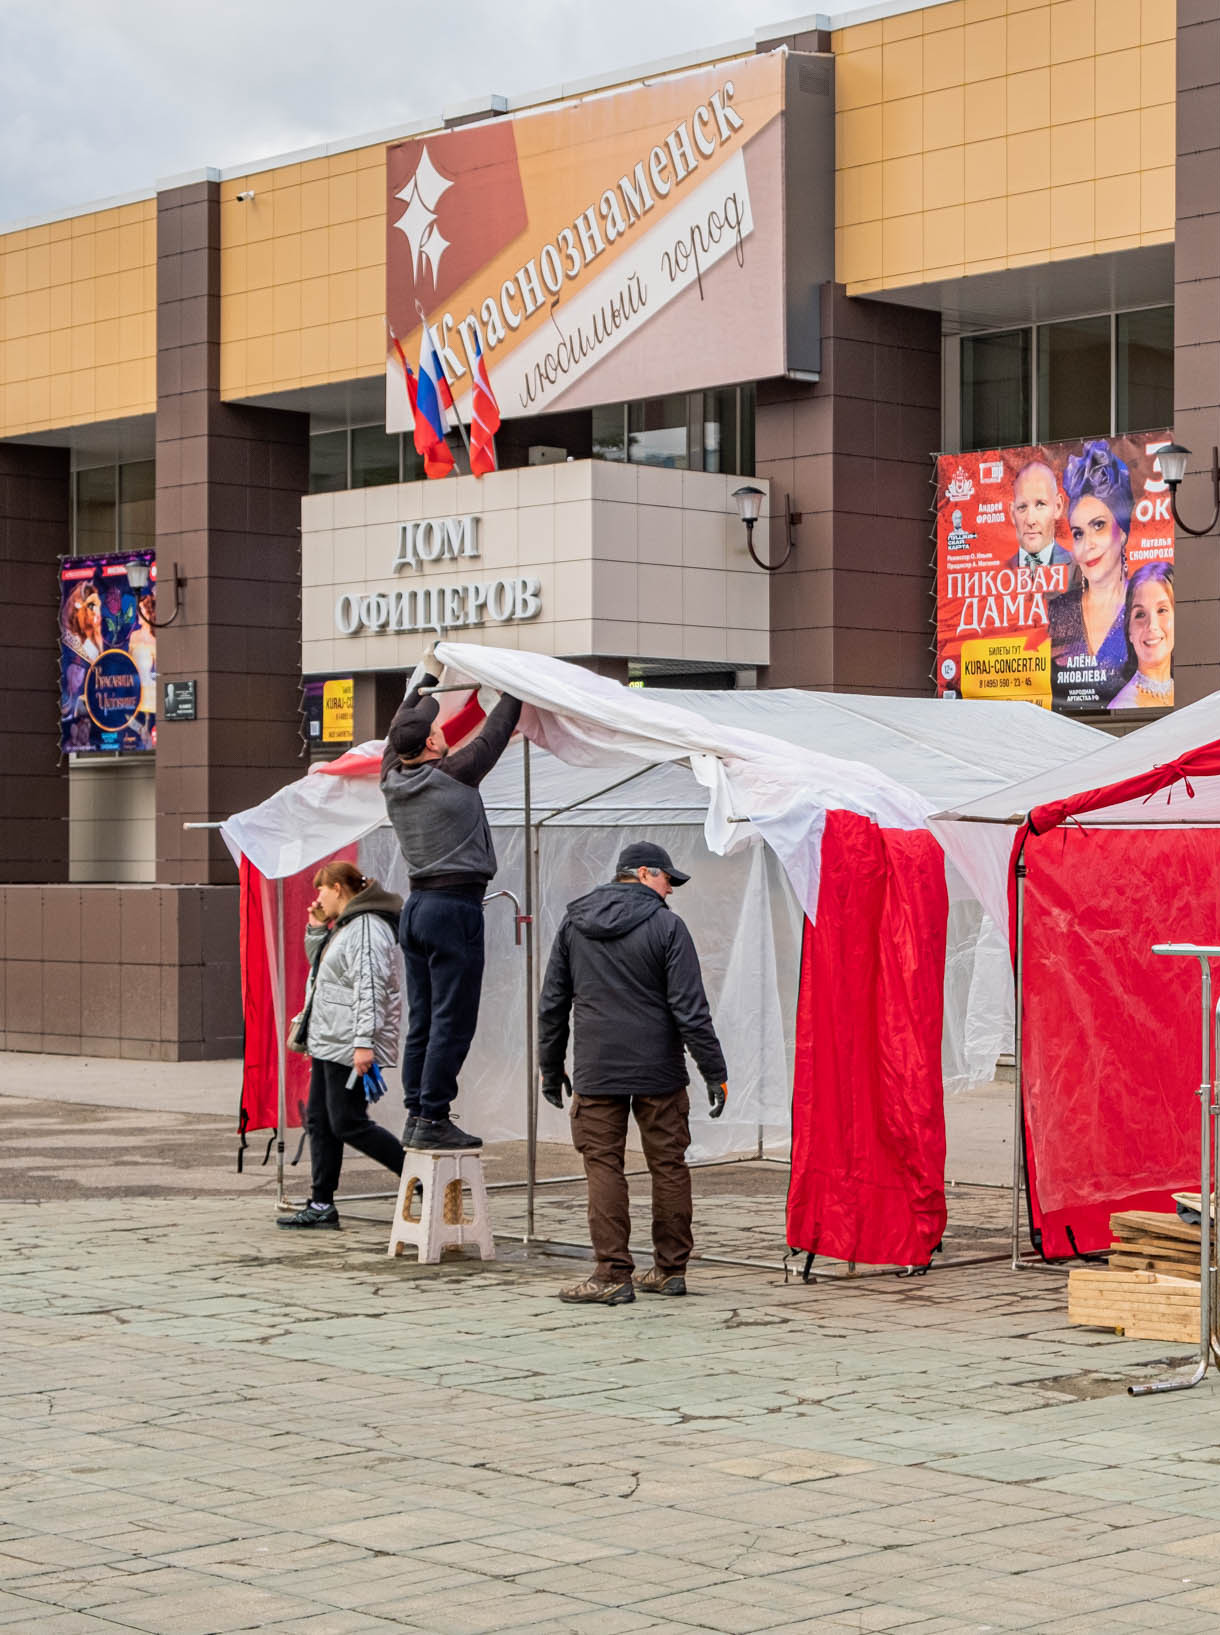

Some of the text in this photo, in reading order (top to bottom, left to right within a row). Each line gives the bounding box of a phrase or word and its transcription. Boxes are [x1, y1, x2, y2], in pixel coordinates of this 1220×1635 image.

[428, 79, 745, 384] Краснознаменск
[518, 191, 745, 409] любимый город
[975, 512, 1005, 524] ФРОЛОВ
[391, 515, 482, 574] ДОМ
[947, 564, 1065, 598] ПИКОВАЯ
[334, 576, 543, 637] ОФИЦЕРОВ
[956, 593, 1049, 636] ДАМА
[988, 645, 1021, 657] БИЛЕТЫ ТУТ
[1066, 653, 1098, 669] АЛЁНА
[944, 664, 953, 675] 12+
[964, 657, 1047, 676] KURAJ-CONCERT.RU
[1056, 669, 1107, 684] ЯКОВЛЕВА
